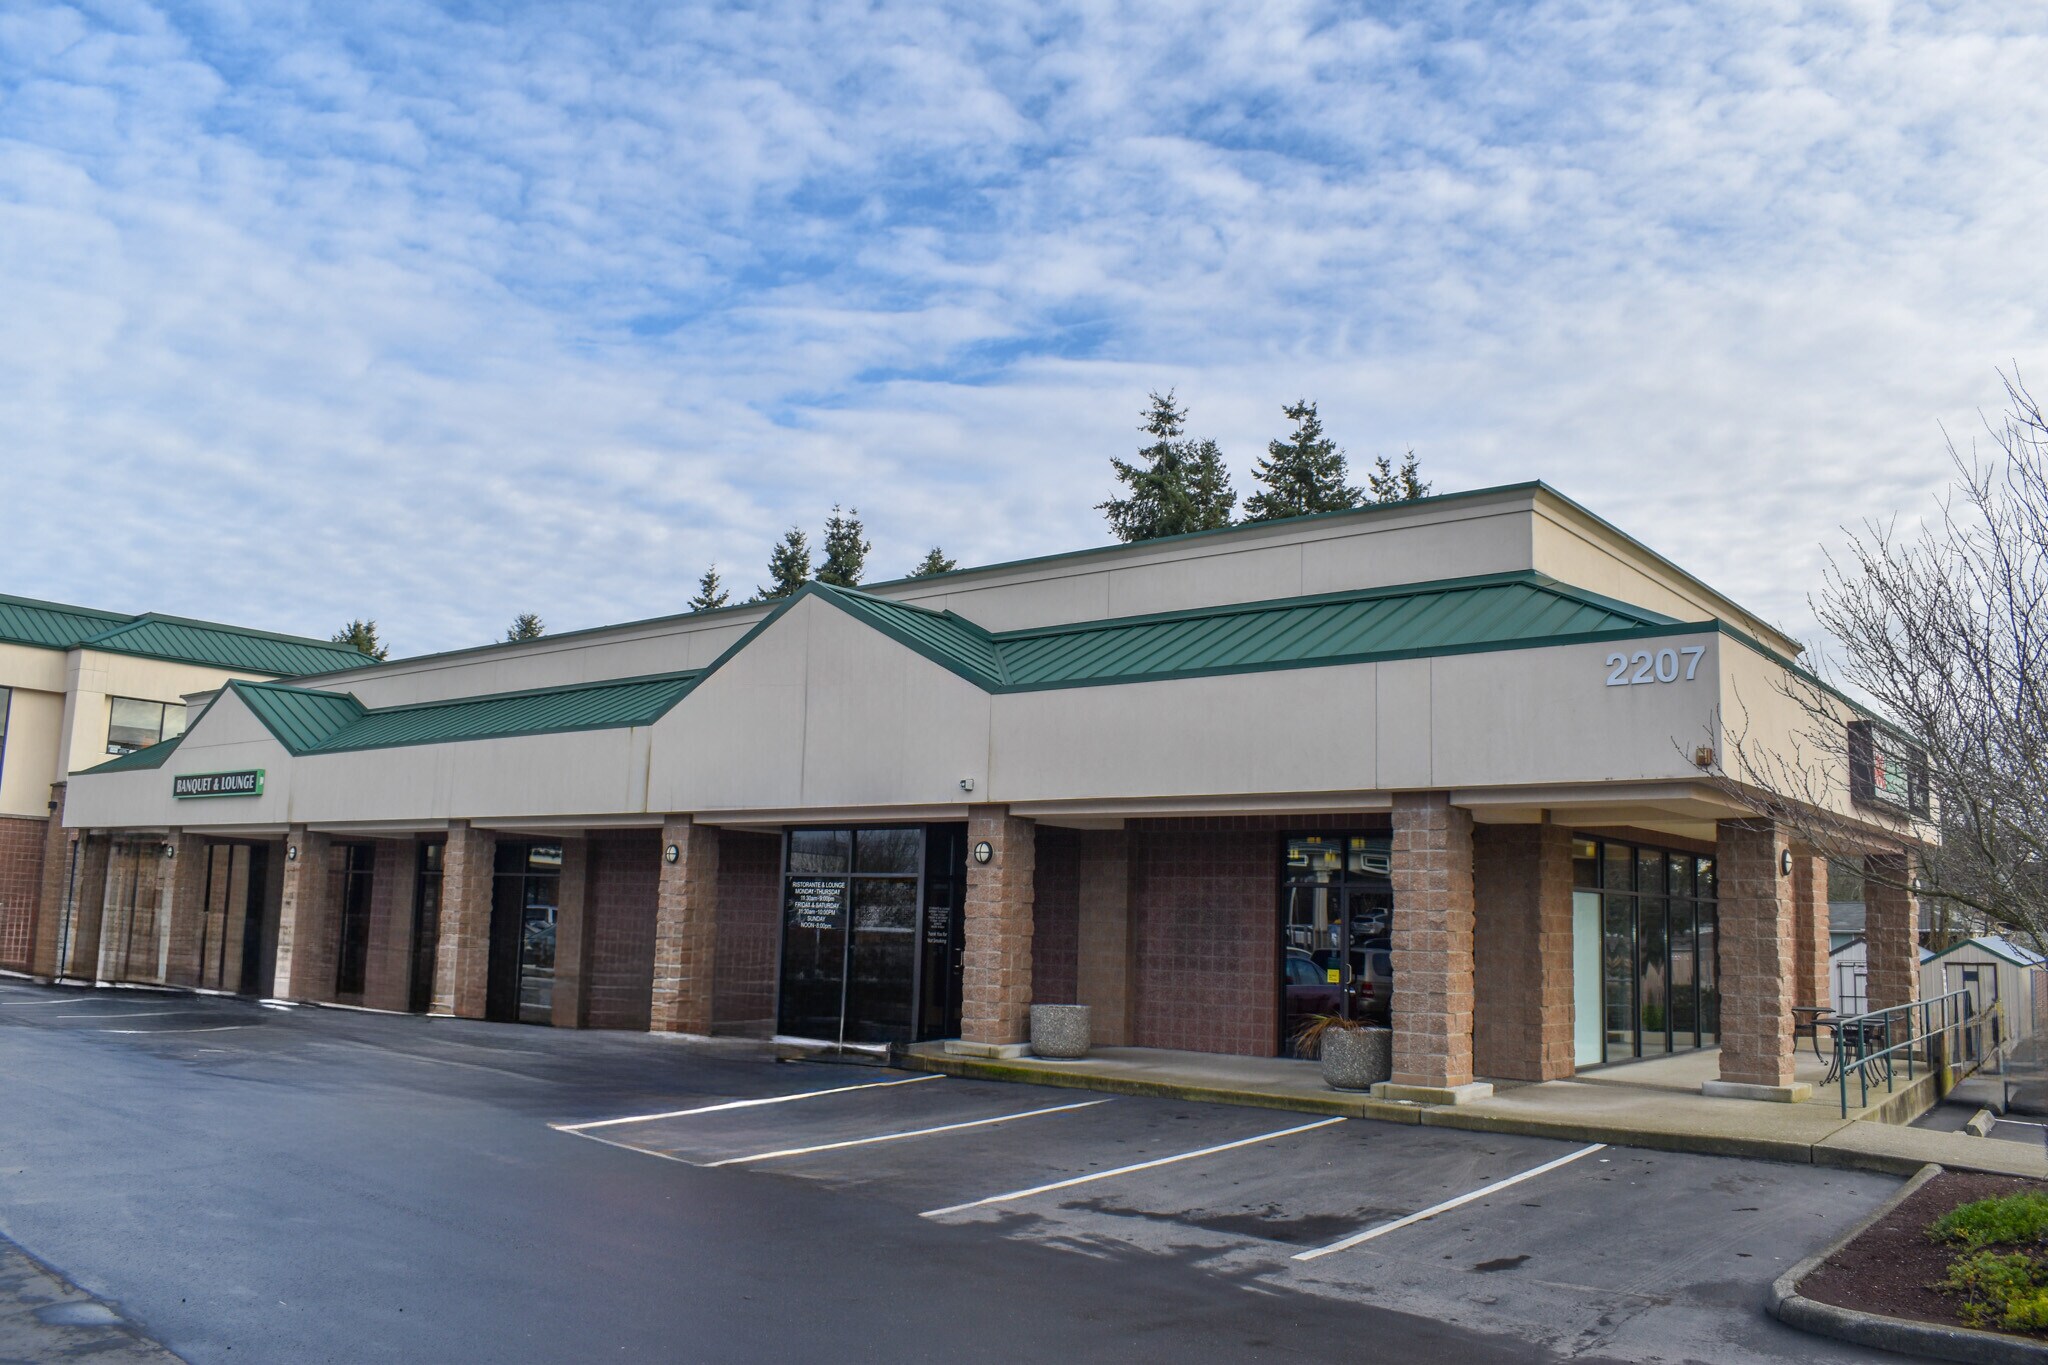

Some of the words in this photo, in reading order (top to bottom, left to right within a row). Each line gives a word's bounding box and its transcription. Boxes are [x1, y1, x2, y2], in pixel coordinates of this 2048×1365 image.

[1606, 645, 1706, 687] 2207
[176, 777, 212, 794] BANQUET
[213, 777, 219, 791] &
[221, 775, 255, 790] LOUNGE
[826, 881, 846, 889] LOUNGE
